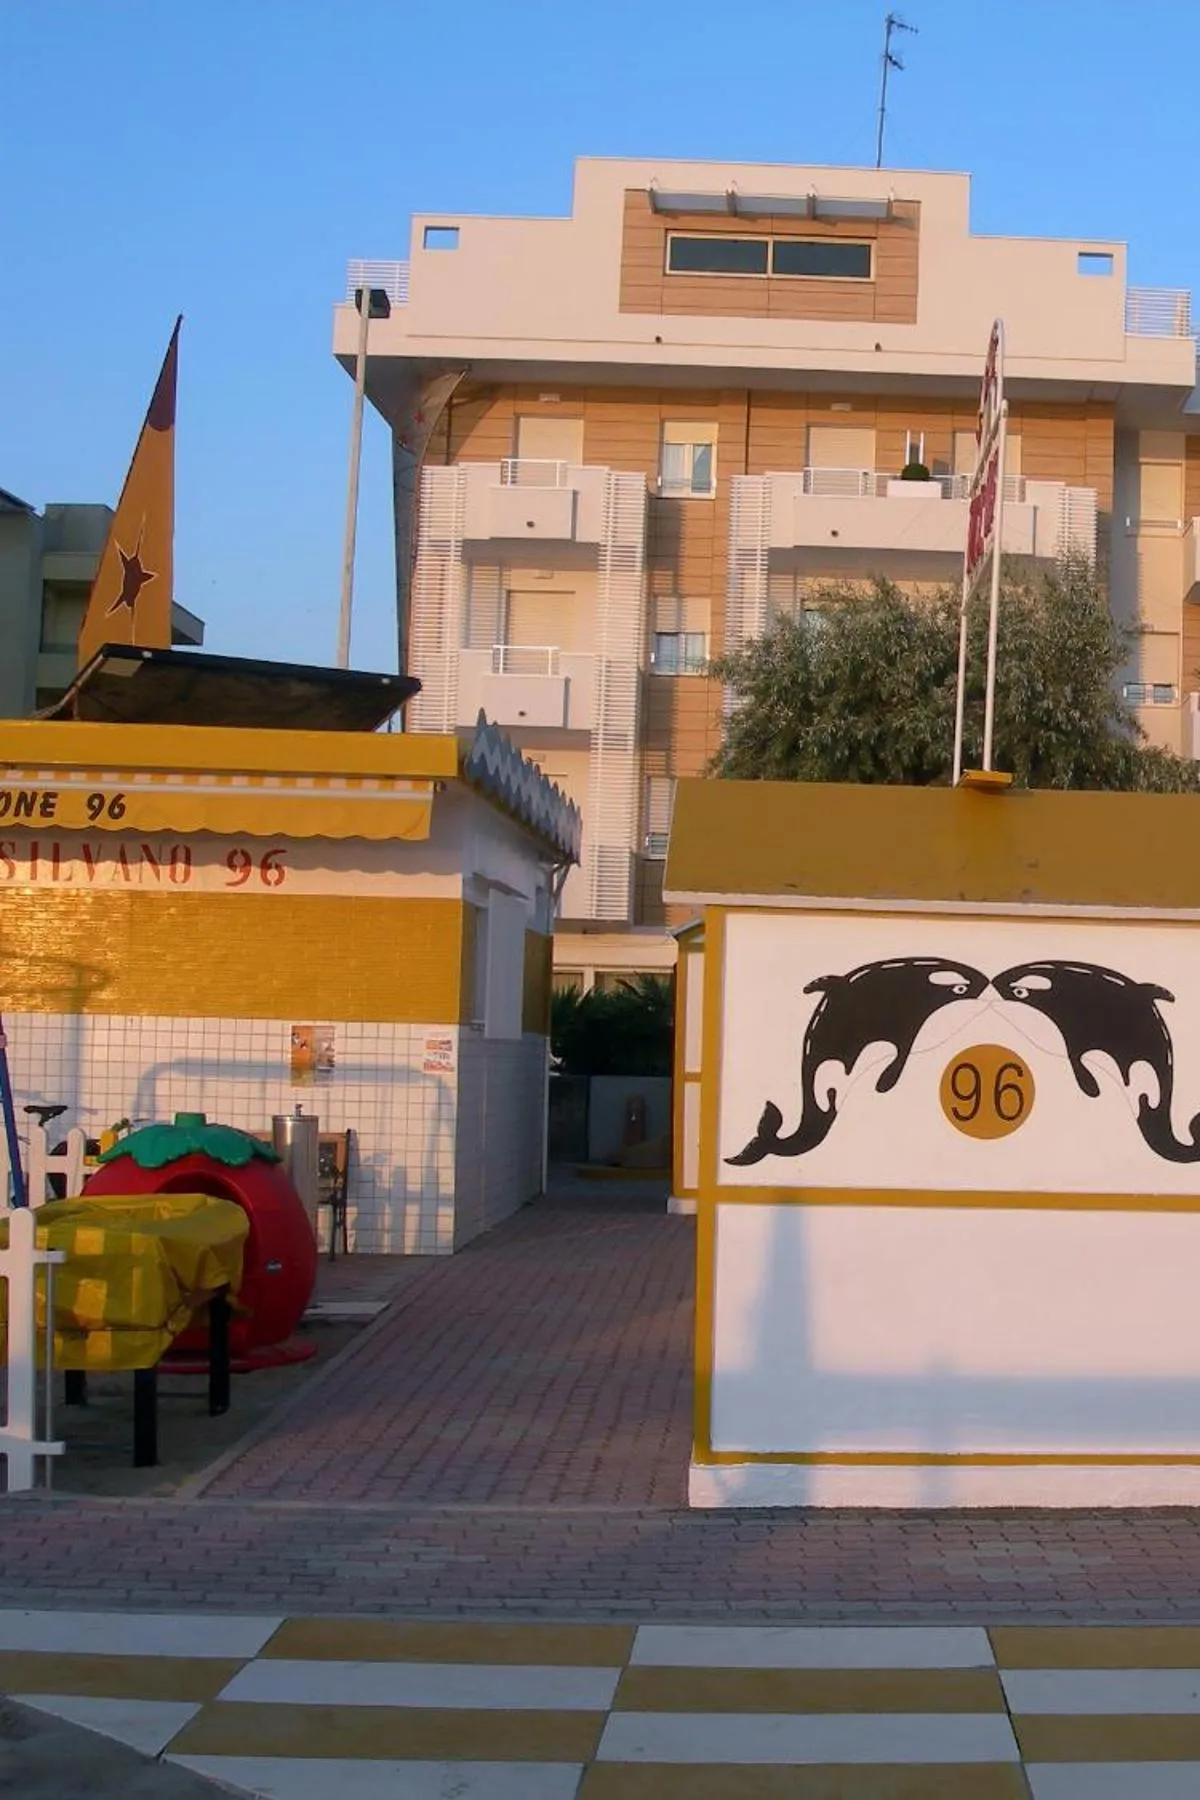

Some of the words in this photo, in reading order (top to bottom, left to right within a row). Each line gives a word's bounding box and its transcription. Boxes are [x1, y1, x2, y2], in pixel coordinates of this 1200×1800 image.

[87, 792, 126, 821] 96
[0, 840, 191, 884] SILVANO
[226, 848, 288, 887] 96
[951, 1062, 1024, 1121] 96
